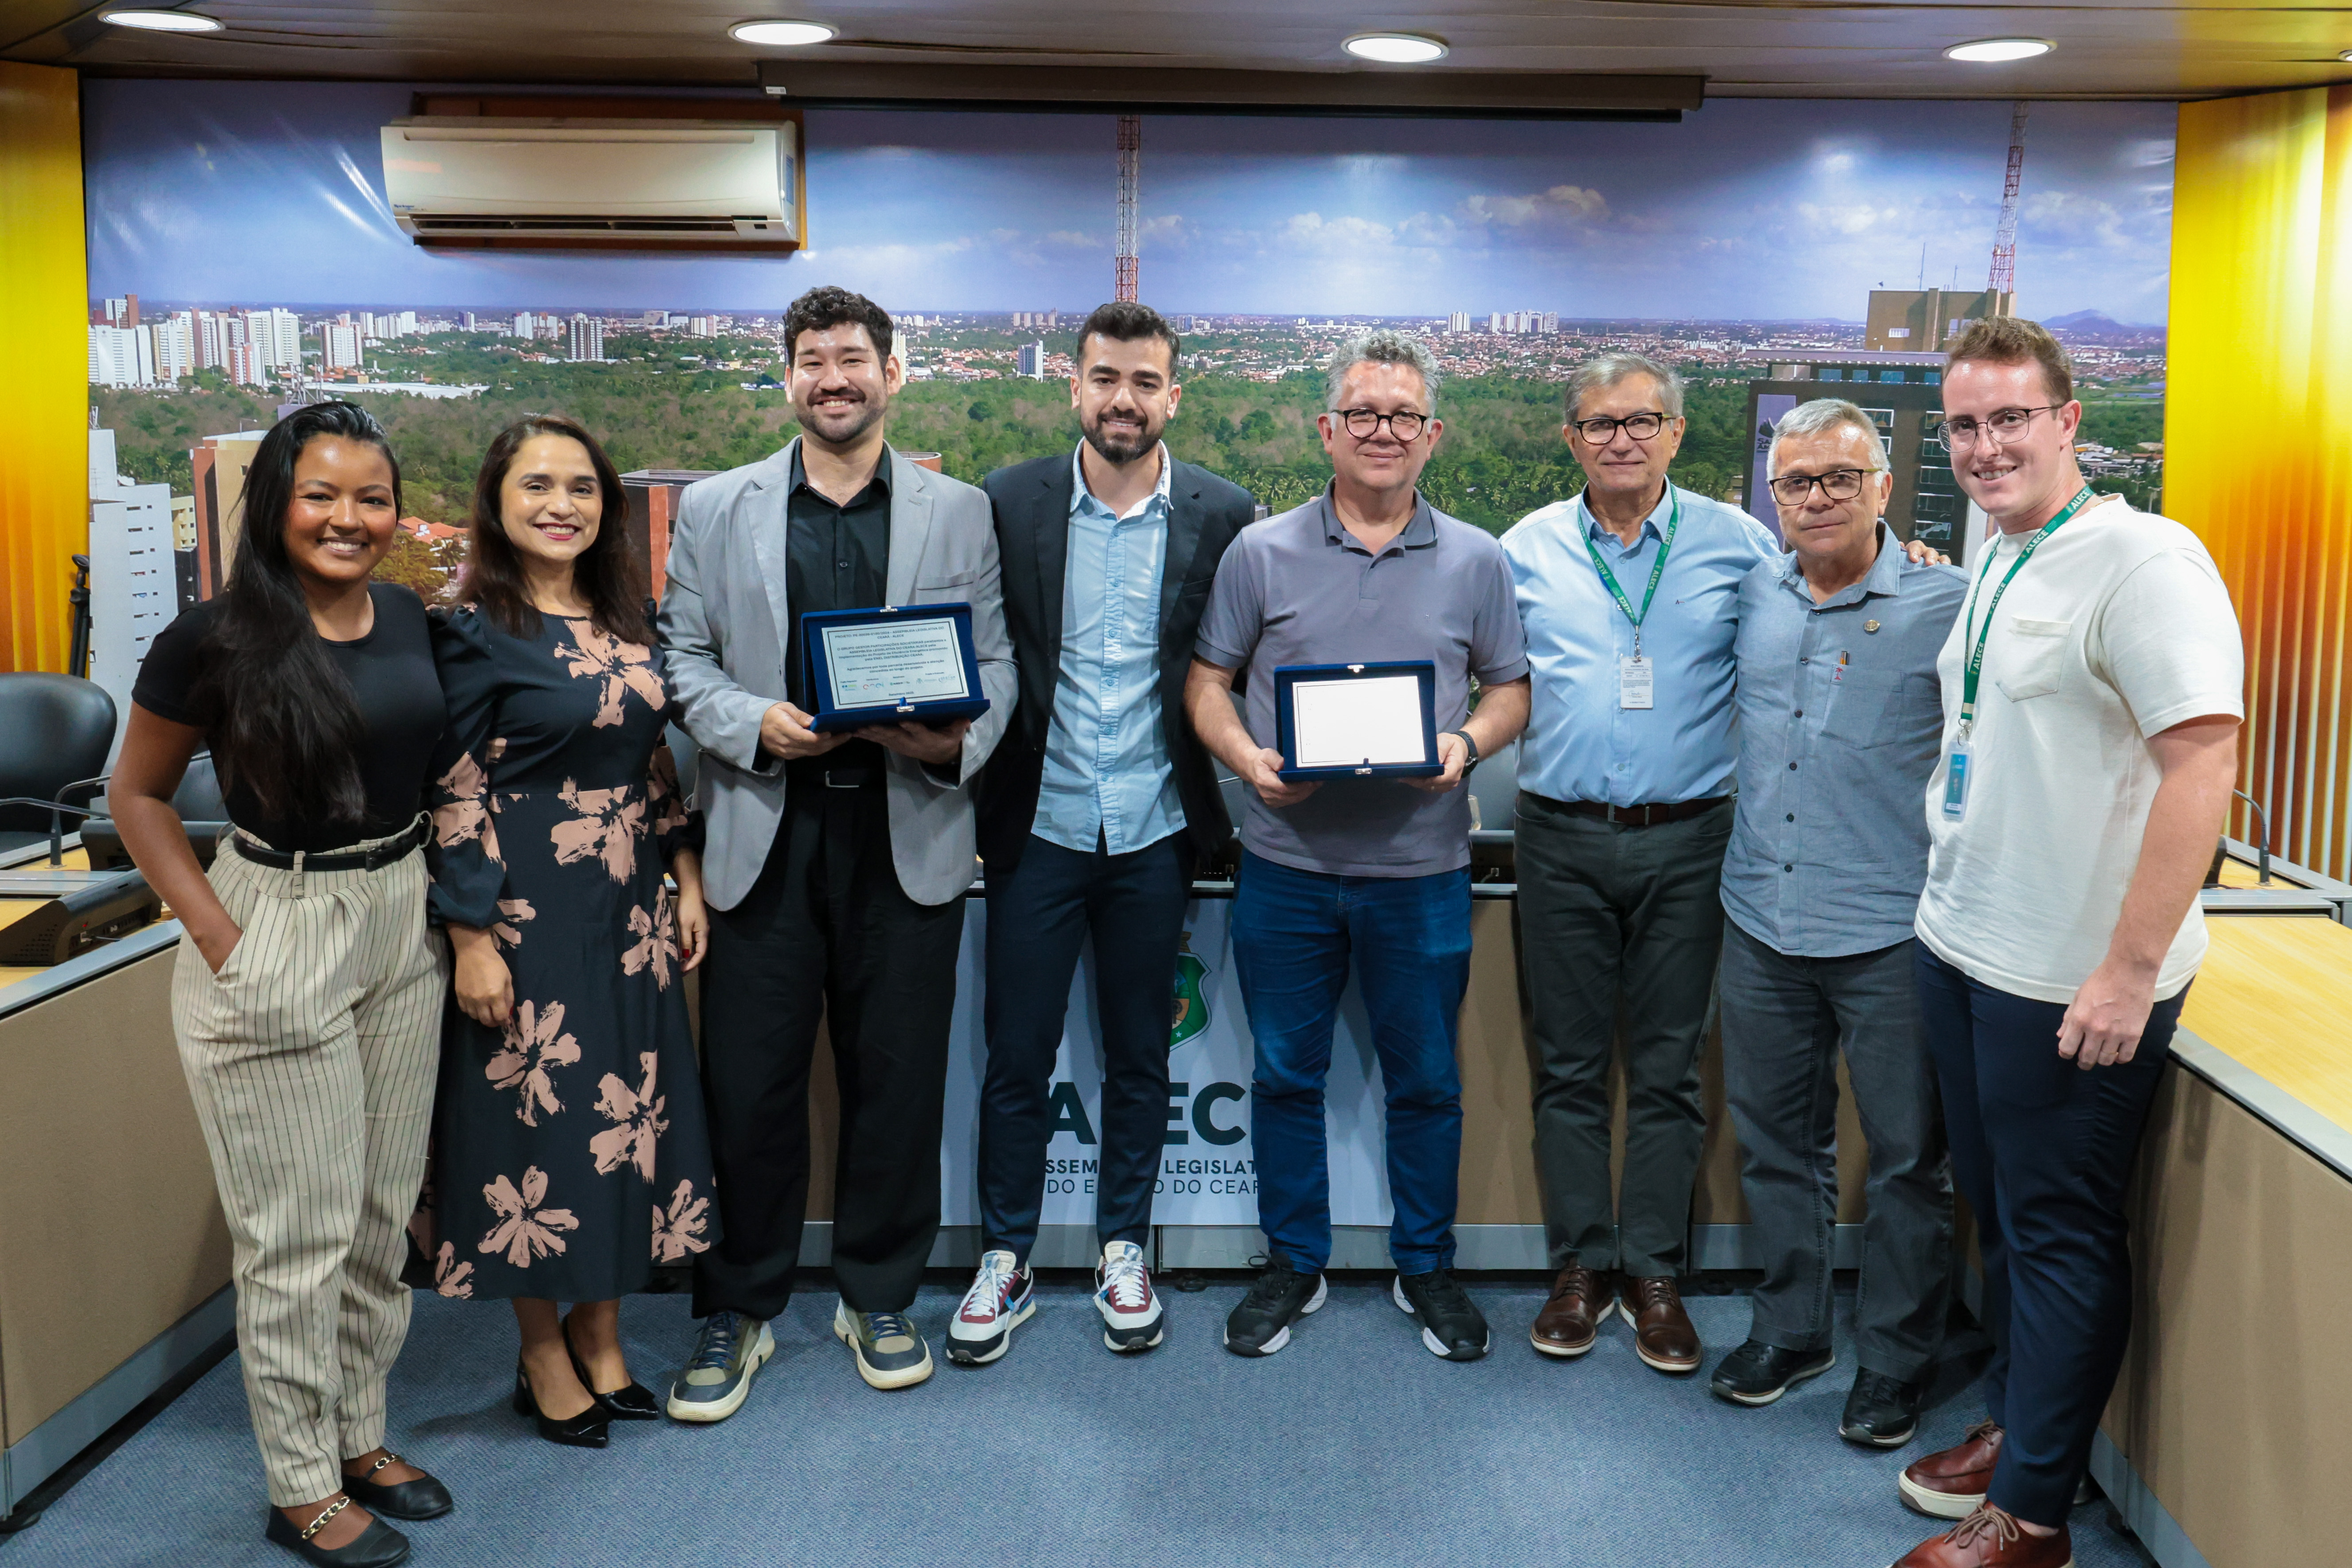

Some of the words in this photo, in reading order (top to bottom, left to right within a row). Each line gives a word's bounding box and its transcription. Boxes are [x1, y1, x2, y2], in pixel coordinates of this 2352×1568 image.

[2071, 490, 2090, 510] ALECE
[1664, 526, 1674, 546] ALECE
[2025, 529, 2048, 553] ALECE
[1594, 557, 1608, 575] ALECE
[1648, 570, 1659, 590] ALECE
[1618, 595, 1633, 613] ALECE
[1990, 583, 2006, 609] ALECE
[1047, 1082, 1256, 1145] AEC
[1165, 1160, 1256, 1174] LEGISLAT
[1047, 1179, 1075, 1193] DO
[1174, 1179, 1201, 1194] DO
[1210, 1179, 1258, 1194] CEA
